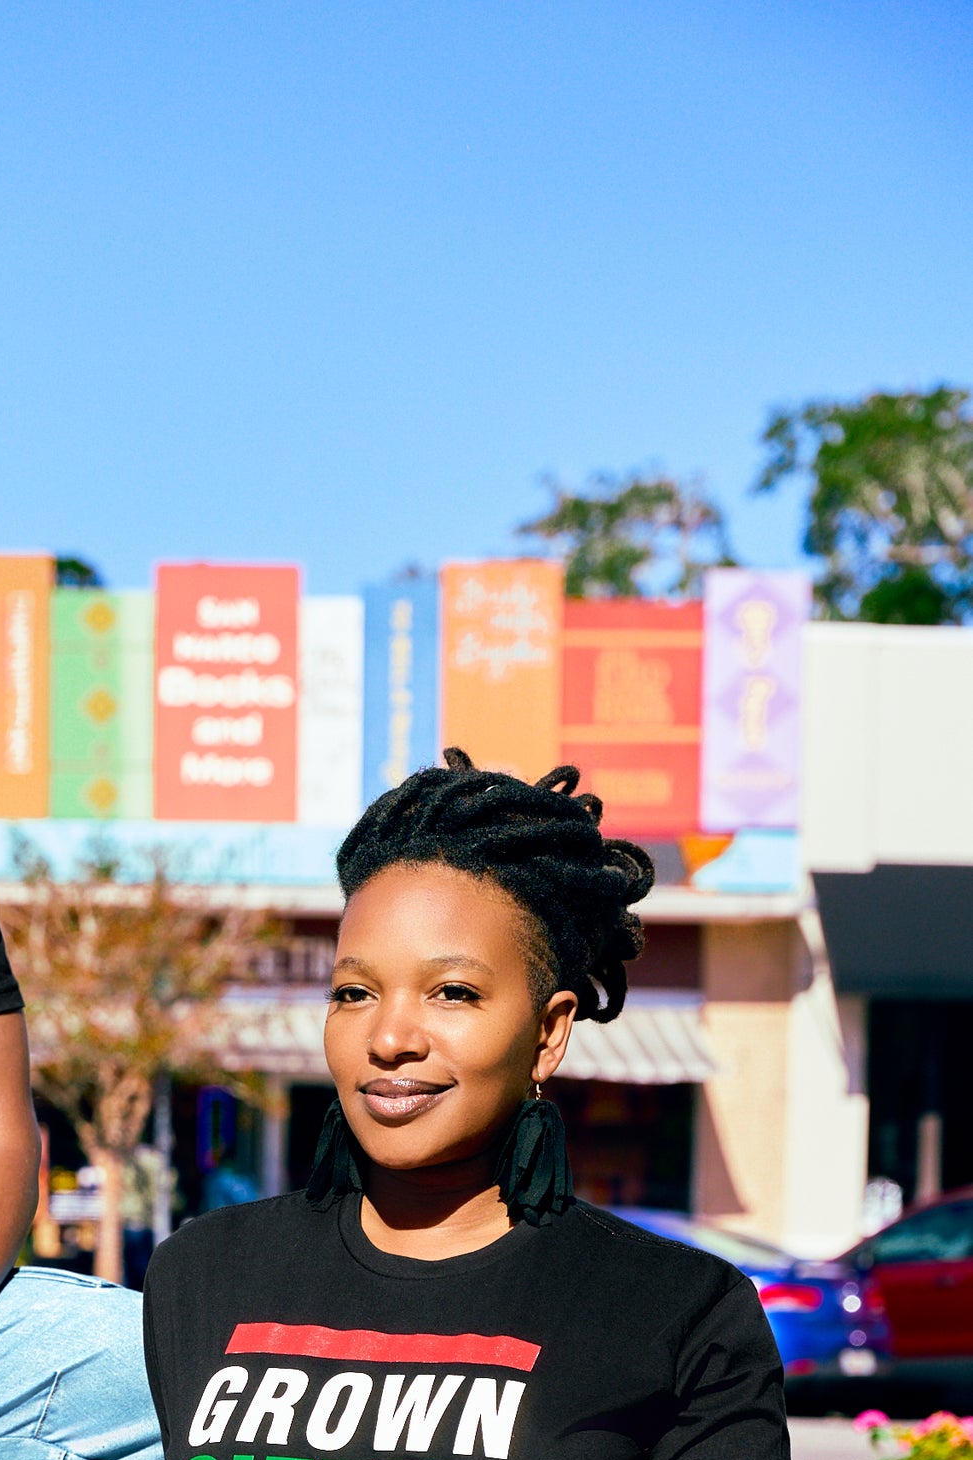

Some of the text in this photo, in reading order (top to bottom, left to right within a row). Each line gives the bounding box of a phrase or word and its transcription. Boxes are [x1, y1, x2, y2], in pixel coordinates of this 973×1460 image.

[192, 711, 264, 746] and
[181, 752, 274, 787] More
[187, 1365, 527, 1460] GROWN
